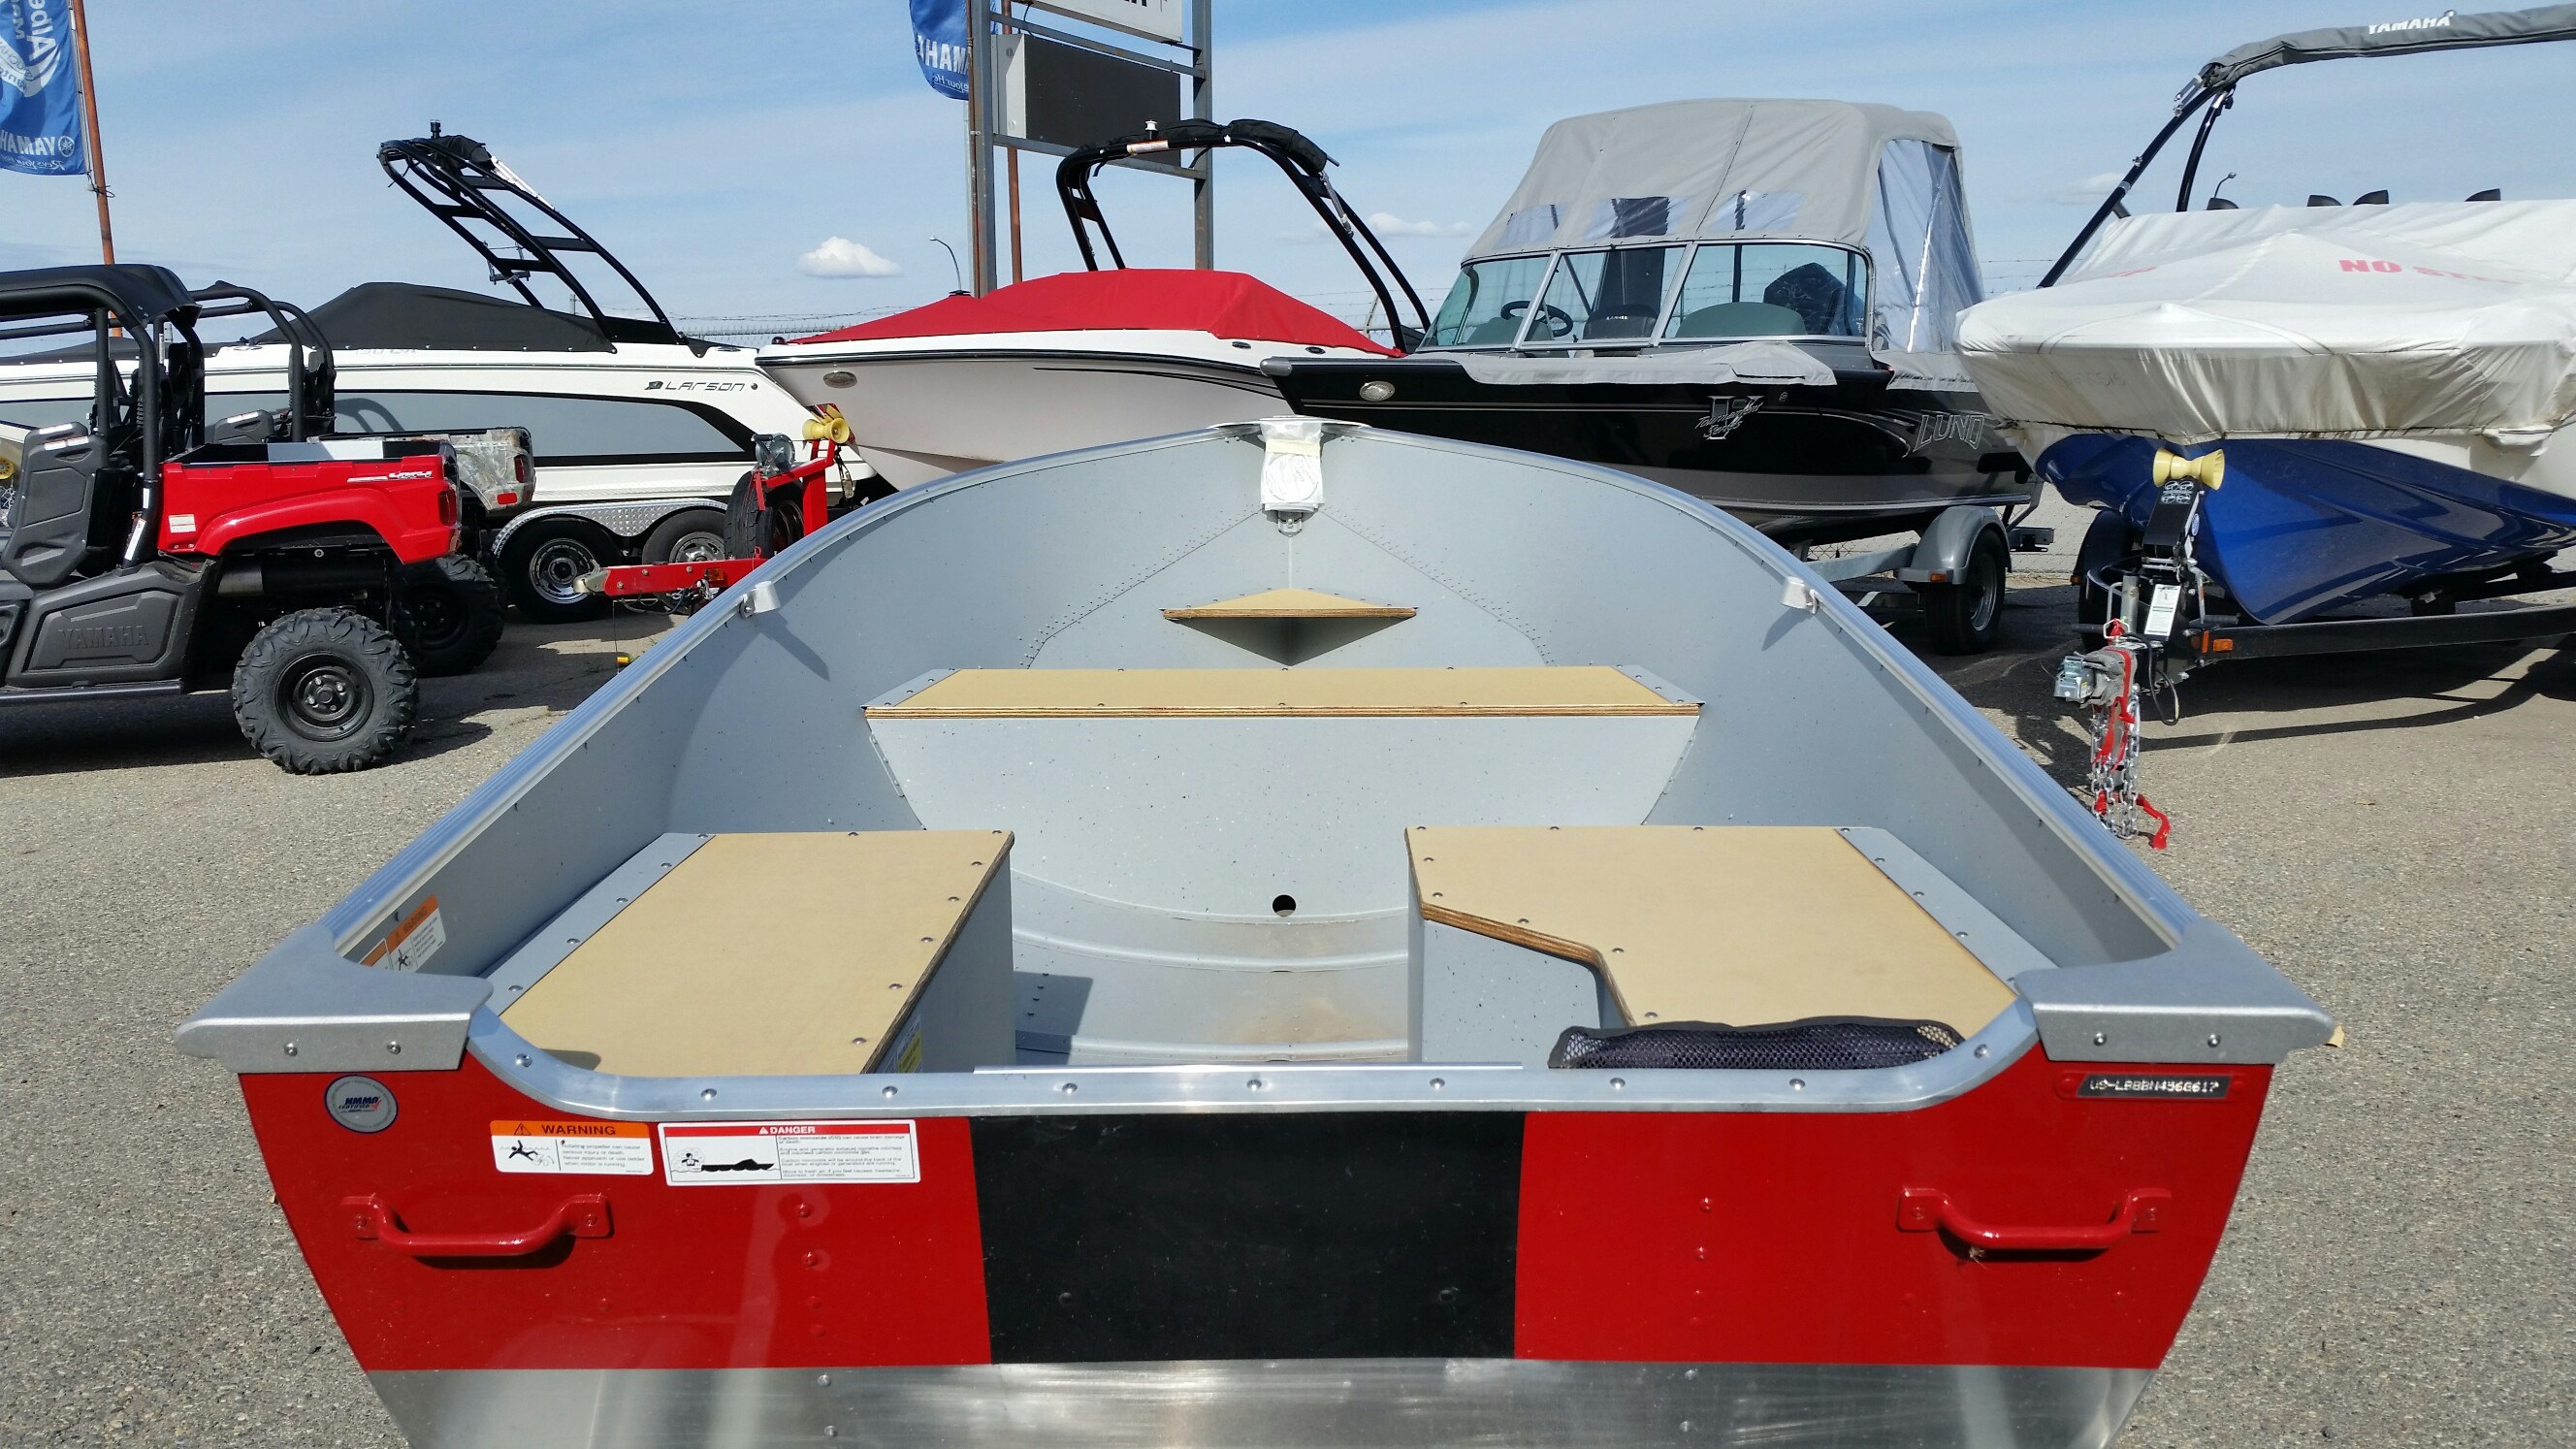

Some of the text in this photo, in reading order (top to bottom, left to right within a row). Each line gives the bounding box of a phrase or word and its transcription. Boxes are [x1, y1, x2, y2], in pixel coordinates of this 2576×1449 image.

[2368, 16, 2451, 35] YAMAHA
[2338, 259, 2403, 274] NO
[1913, 414, 1985, 454] LUND
[58, 625, 150, 650] YAMAHA
[541, 1124, 616, 1136] WARNING
